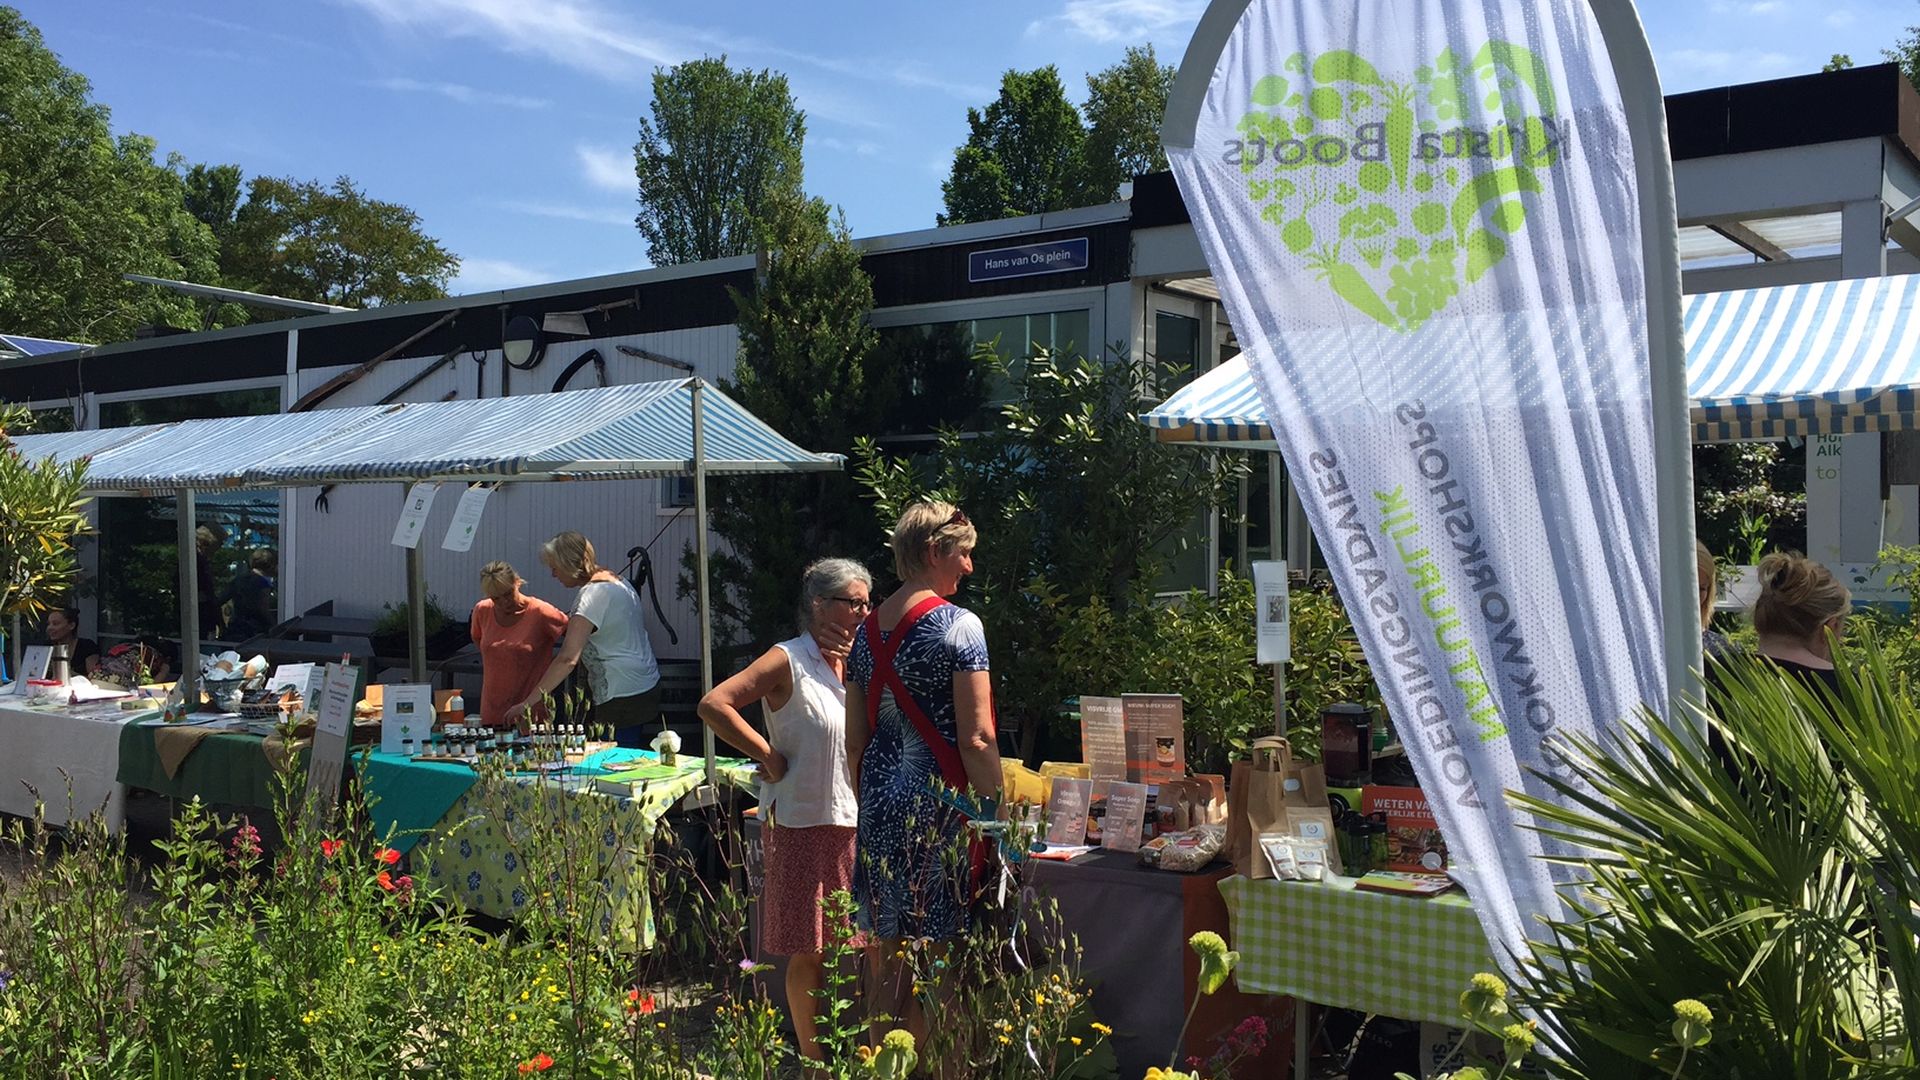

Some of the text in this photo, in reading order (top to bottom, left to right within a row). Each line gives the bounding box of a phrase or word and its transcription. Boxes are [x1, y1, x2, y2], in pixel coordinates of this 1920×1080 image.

[984, 249, 1071, 270] Hans van Os plein
[1816, 443, 1841, 456] Alk
[1816, 466, 1840, 480] to
[1373, 798, 1430, 810] WETEN VA
